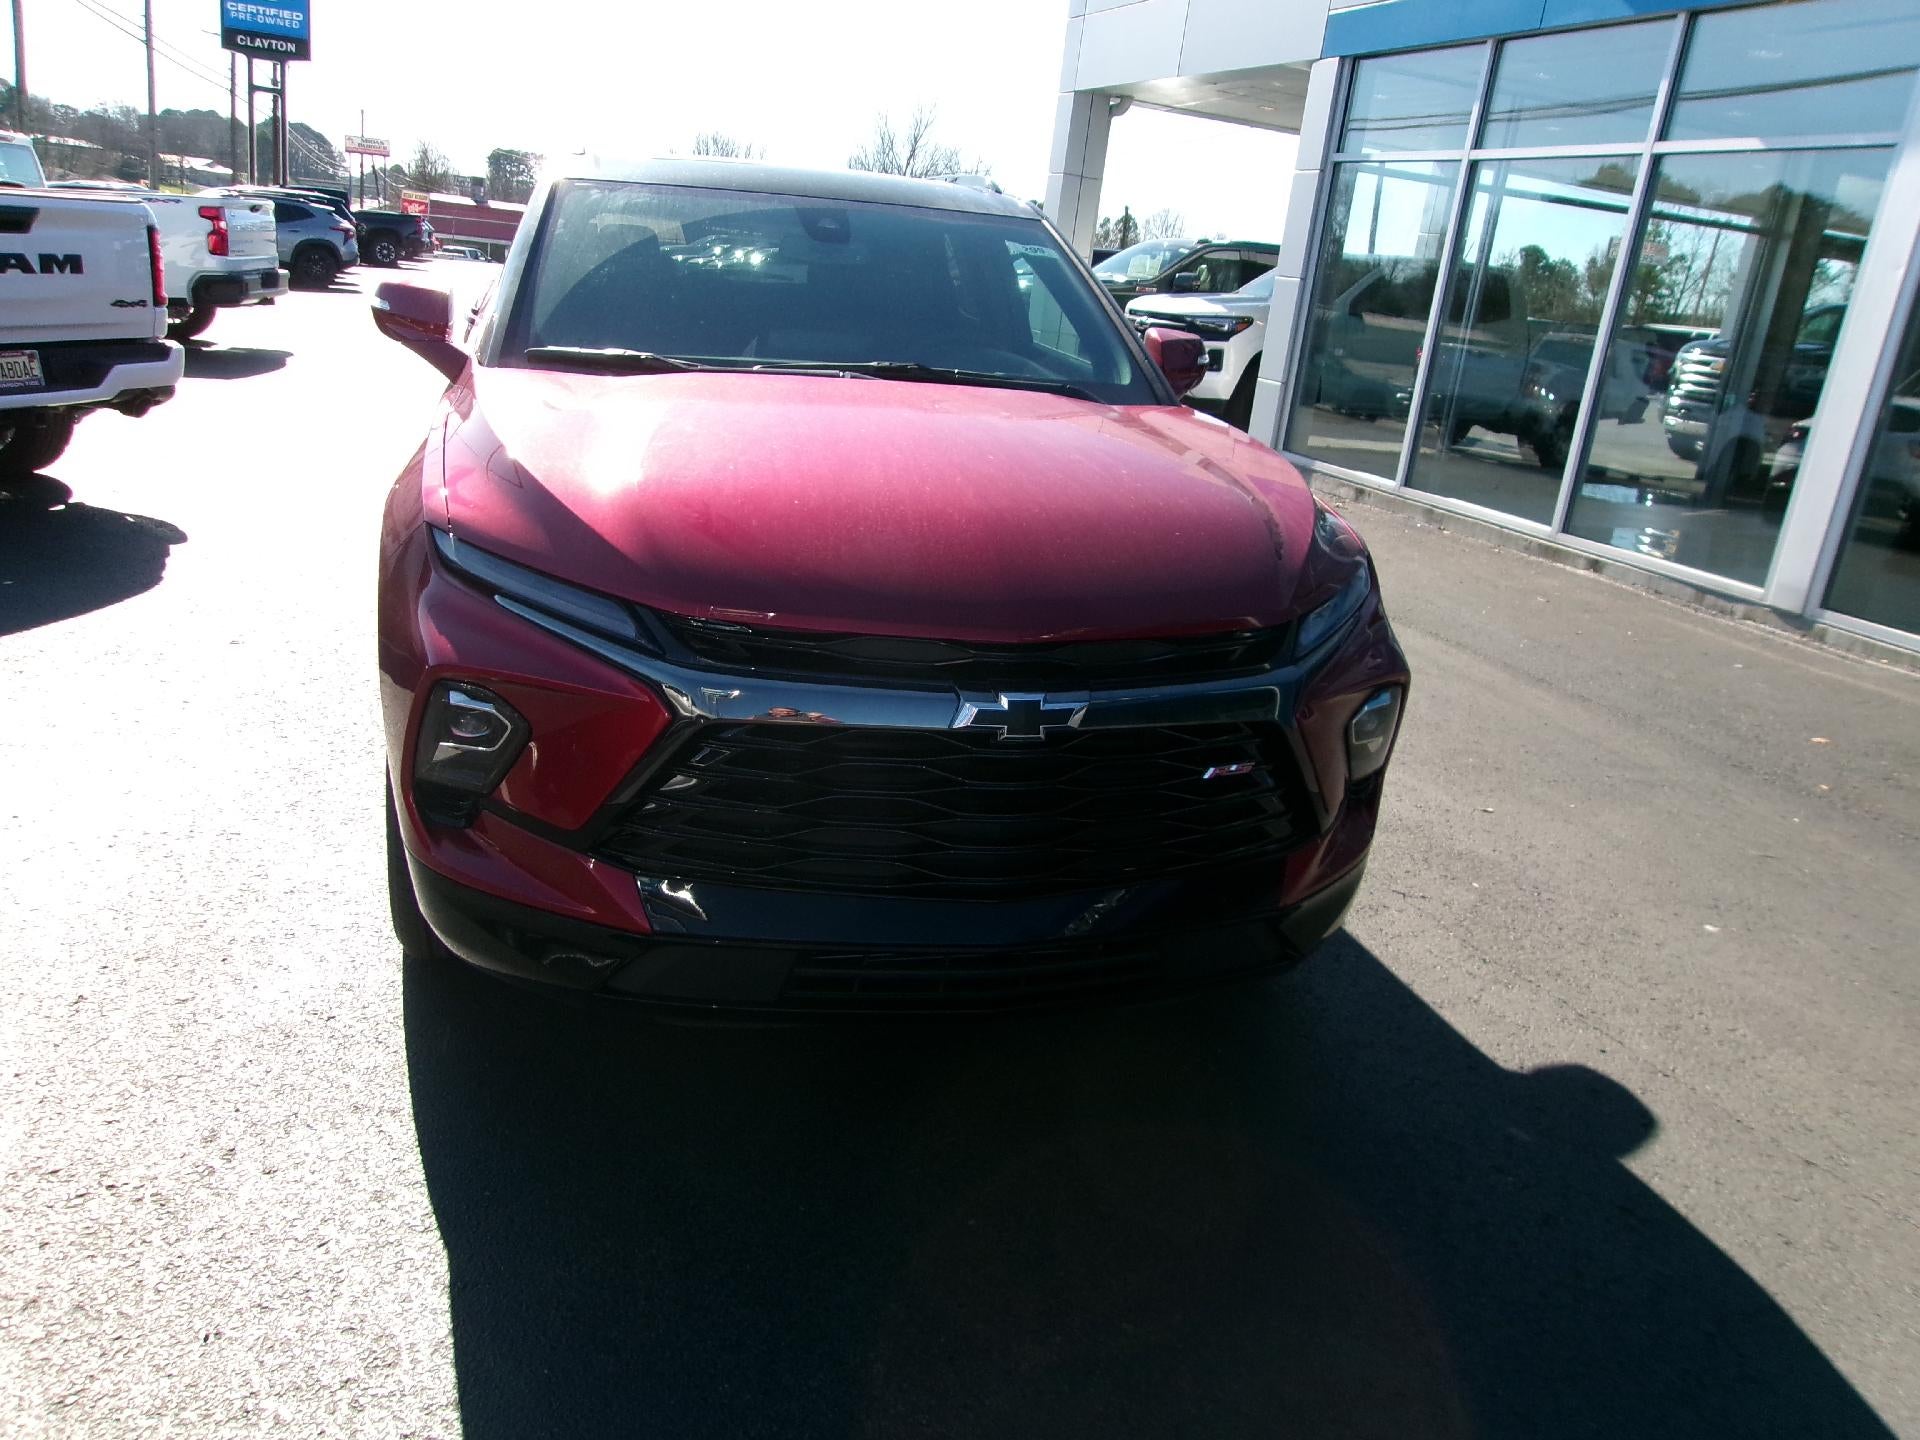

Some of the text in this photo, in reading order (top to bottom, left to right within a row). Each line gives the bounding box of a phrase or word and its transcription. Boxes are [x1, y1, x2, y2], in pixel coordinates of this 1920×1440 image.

[226, 2, 303, 20] CERTIFIED
[231, 11, 300, 28] PRE-OWNED
[237, 35, 296, 52] CLAYTON
